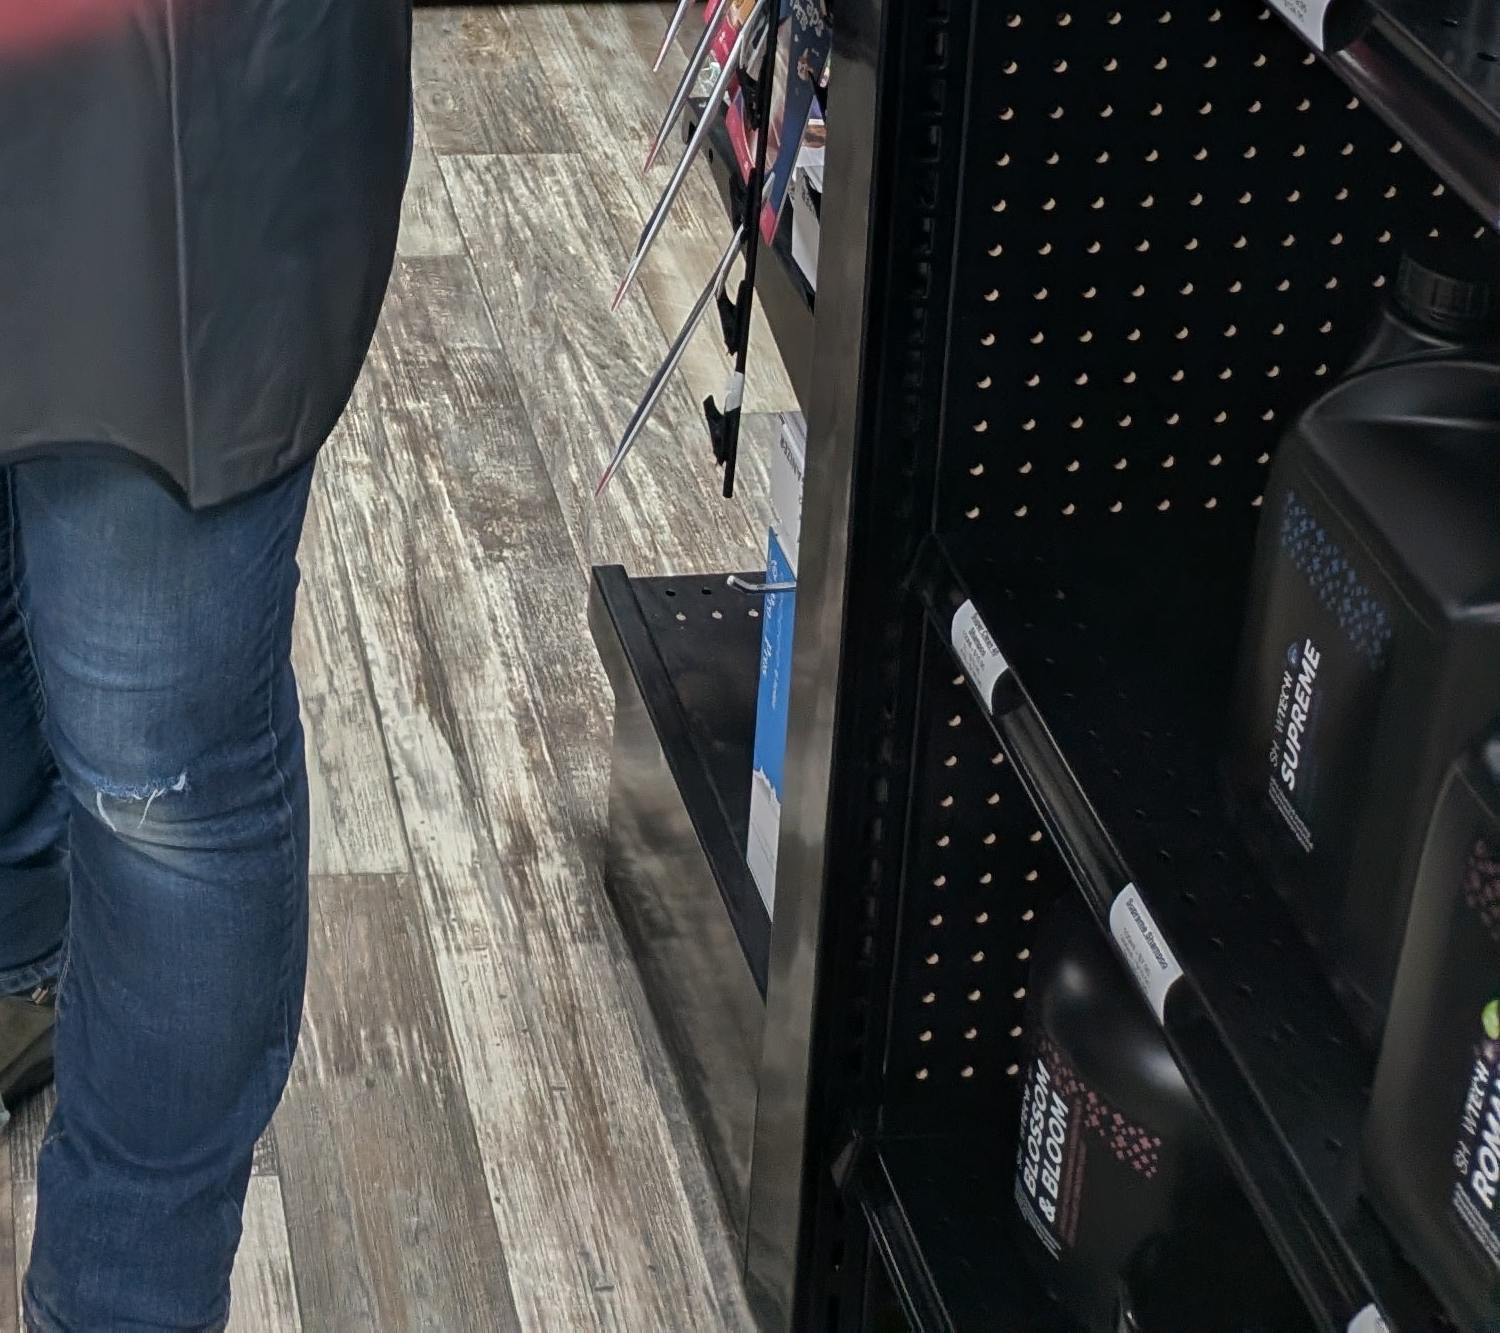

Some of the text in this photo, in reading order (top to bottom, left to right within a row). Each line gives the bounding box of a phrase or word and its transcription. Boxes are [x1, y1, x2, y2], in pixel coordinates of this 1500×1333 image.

[1281, 637, 1322, 792] SUPREME
[1024, 1058, 1051, 1199] BLOSSOM
[1041, 1091, 1069, 1201] BLOOM
[1038, 1196, 1057, 1223] &
